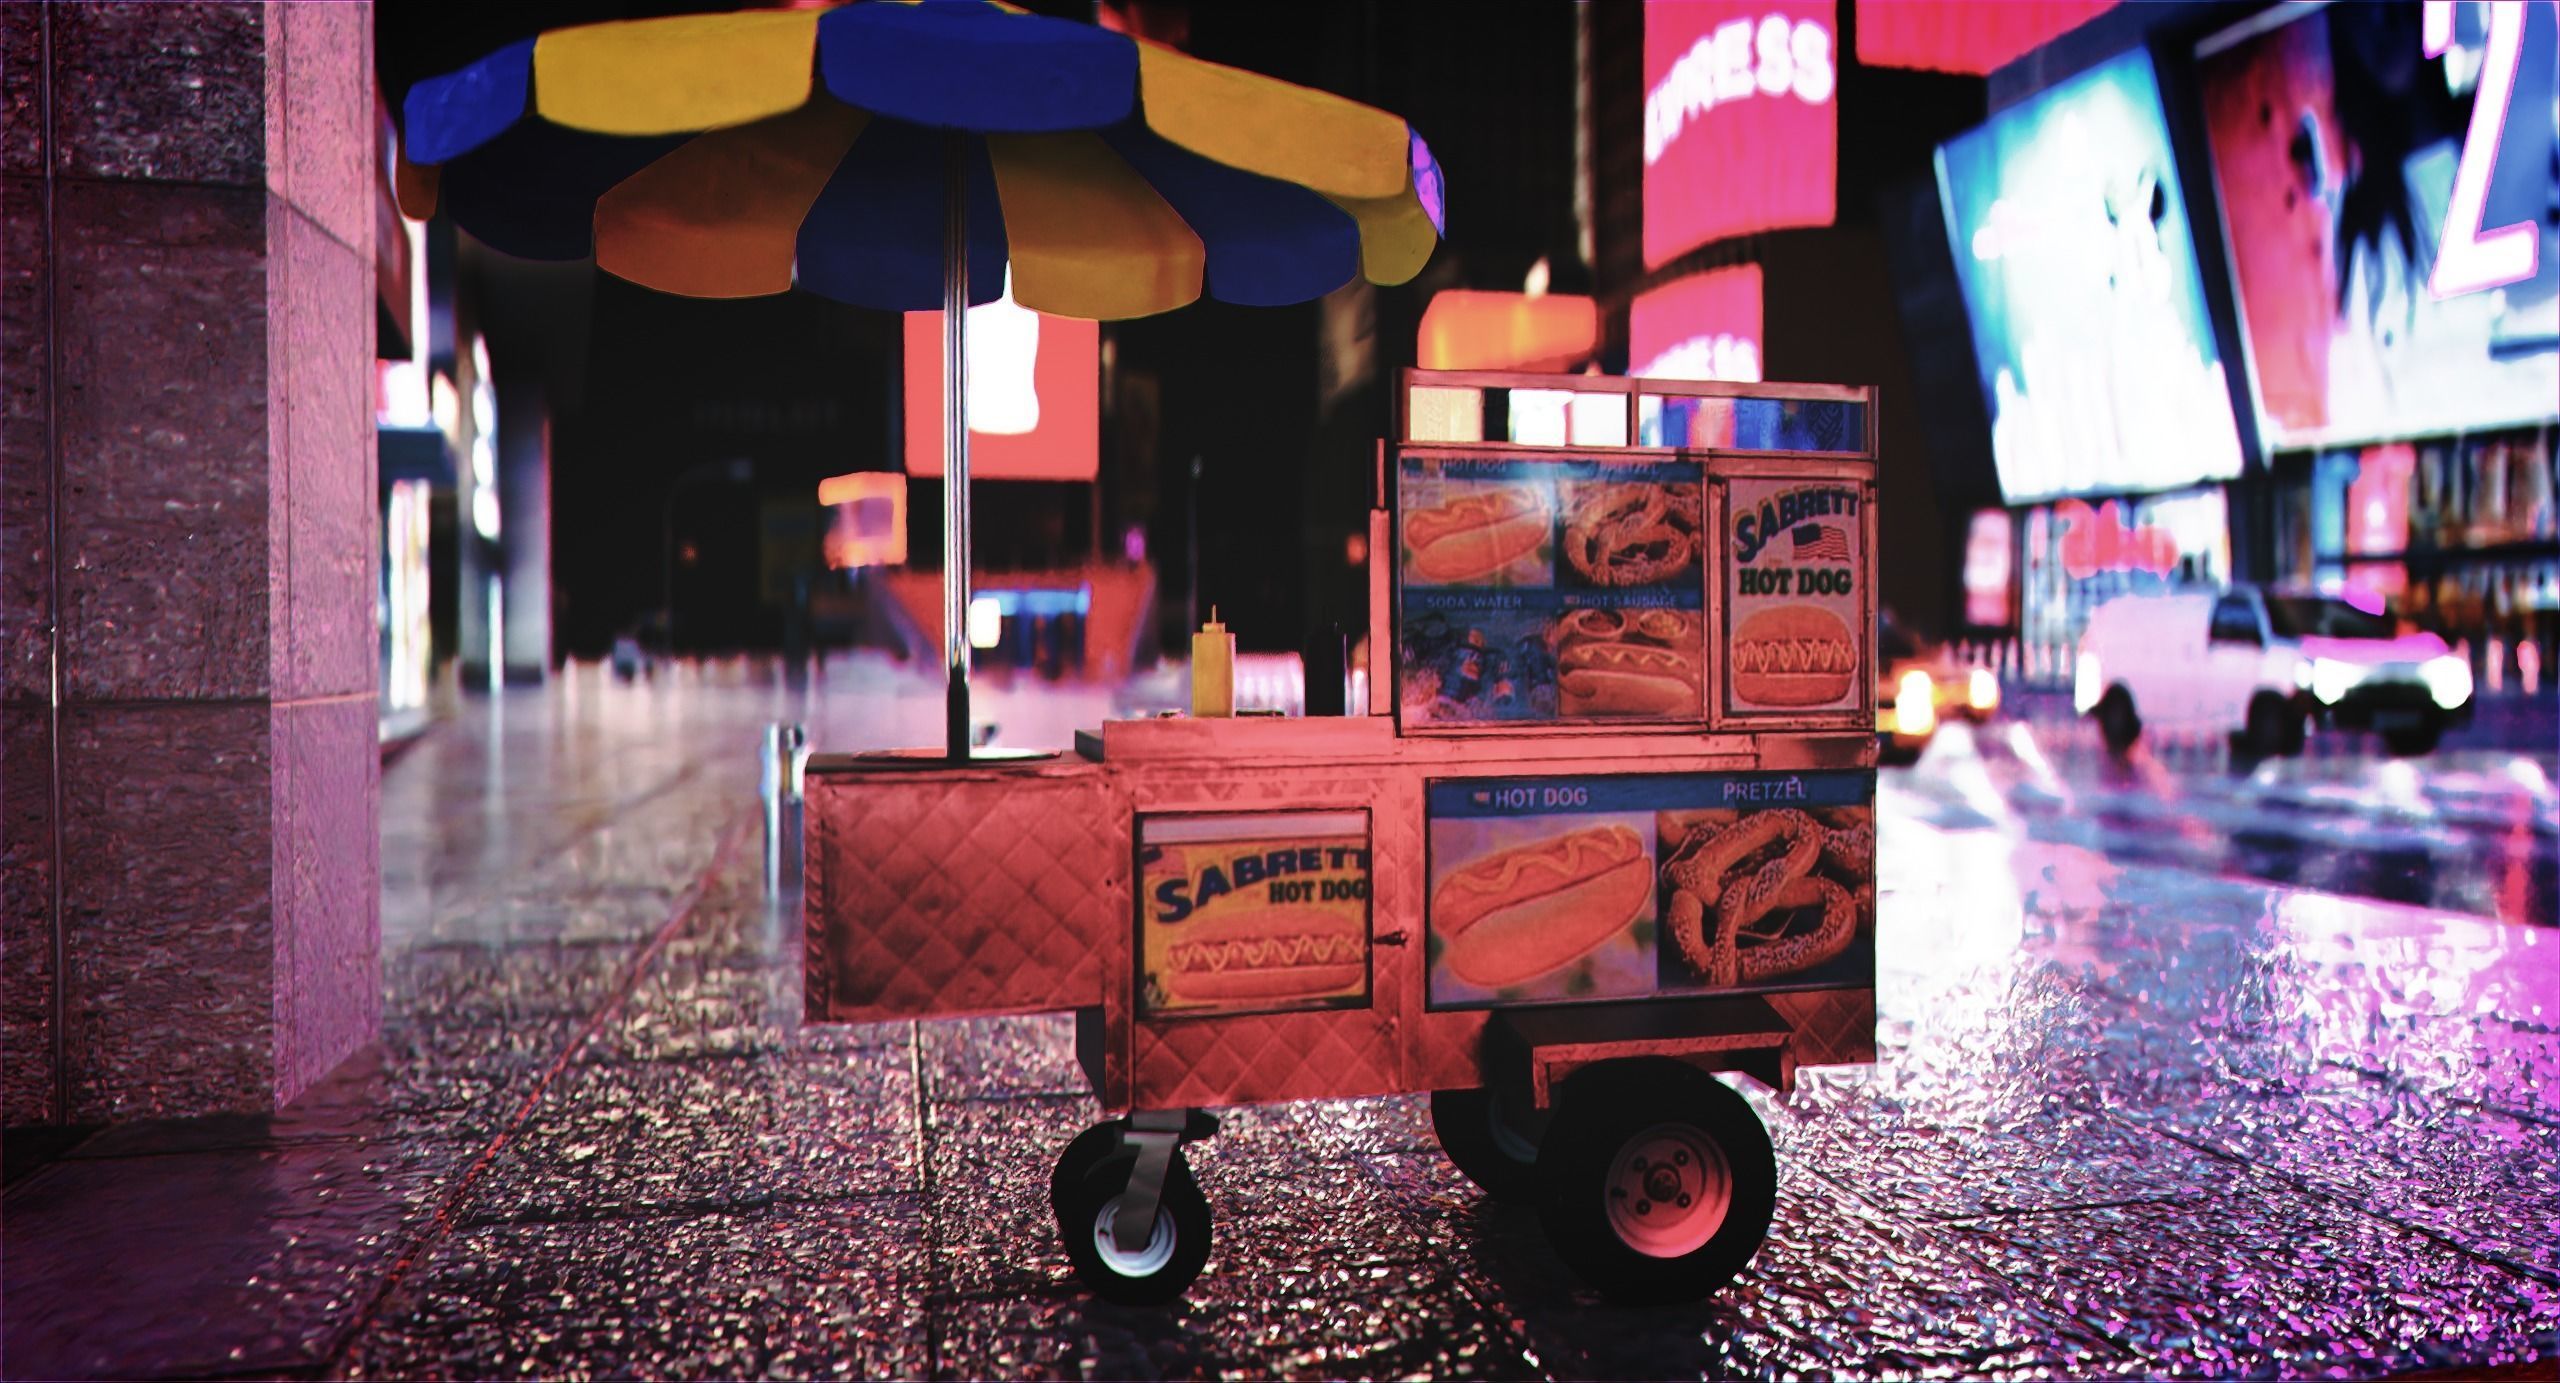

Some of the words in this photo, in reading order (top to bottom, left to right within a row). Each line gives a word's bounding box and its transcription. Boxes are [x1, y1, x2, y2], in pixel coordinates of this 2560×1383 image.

[1734, 486, 1858, 563] SABRETT
[1739, 567, 1793, 596] HOT
[1797, 567, 1853, 596] DOG
[1426, 595, 1466, 609] SODA
[1472, 594, 1522, 609] WATER
[1580, 595, 1609, 608] HOT
[1613, 594, 1678, 608] SAUSAGE
[1495, 788, 1536, 809] HOT
[1543, 786, 1589, 808] DOG
[1722, 779, 1808, 801] PRETZEL
[1155, 846, 1368, 924] SABRETT
[1269, 880, 1316, 905] HOT
[1320, 878, 1368, 902] DOG
